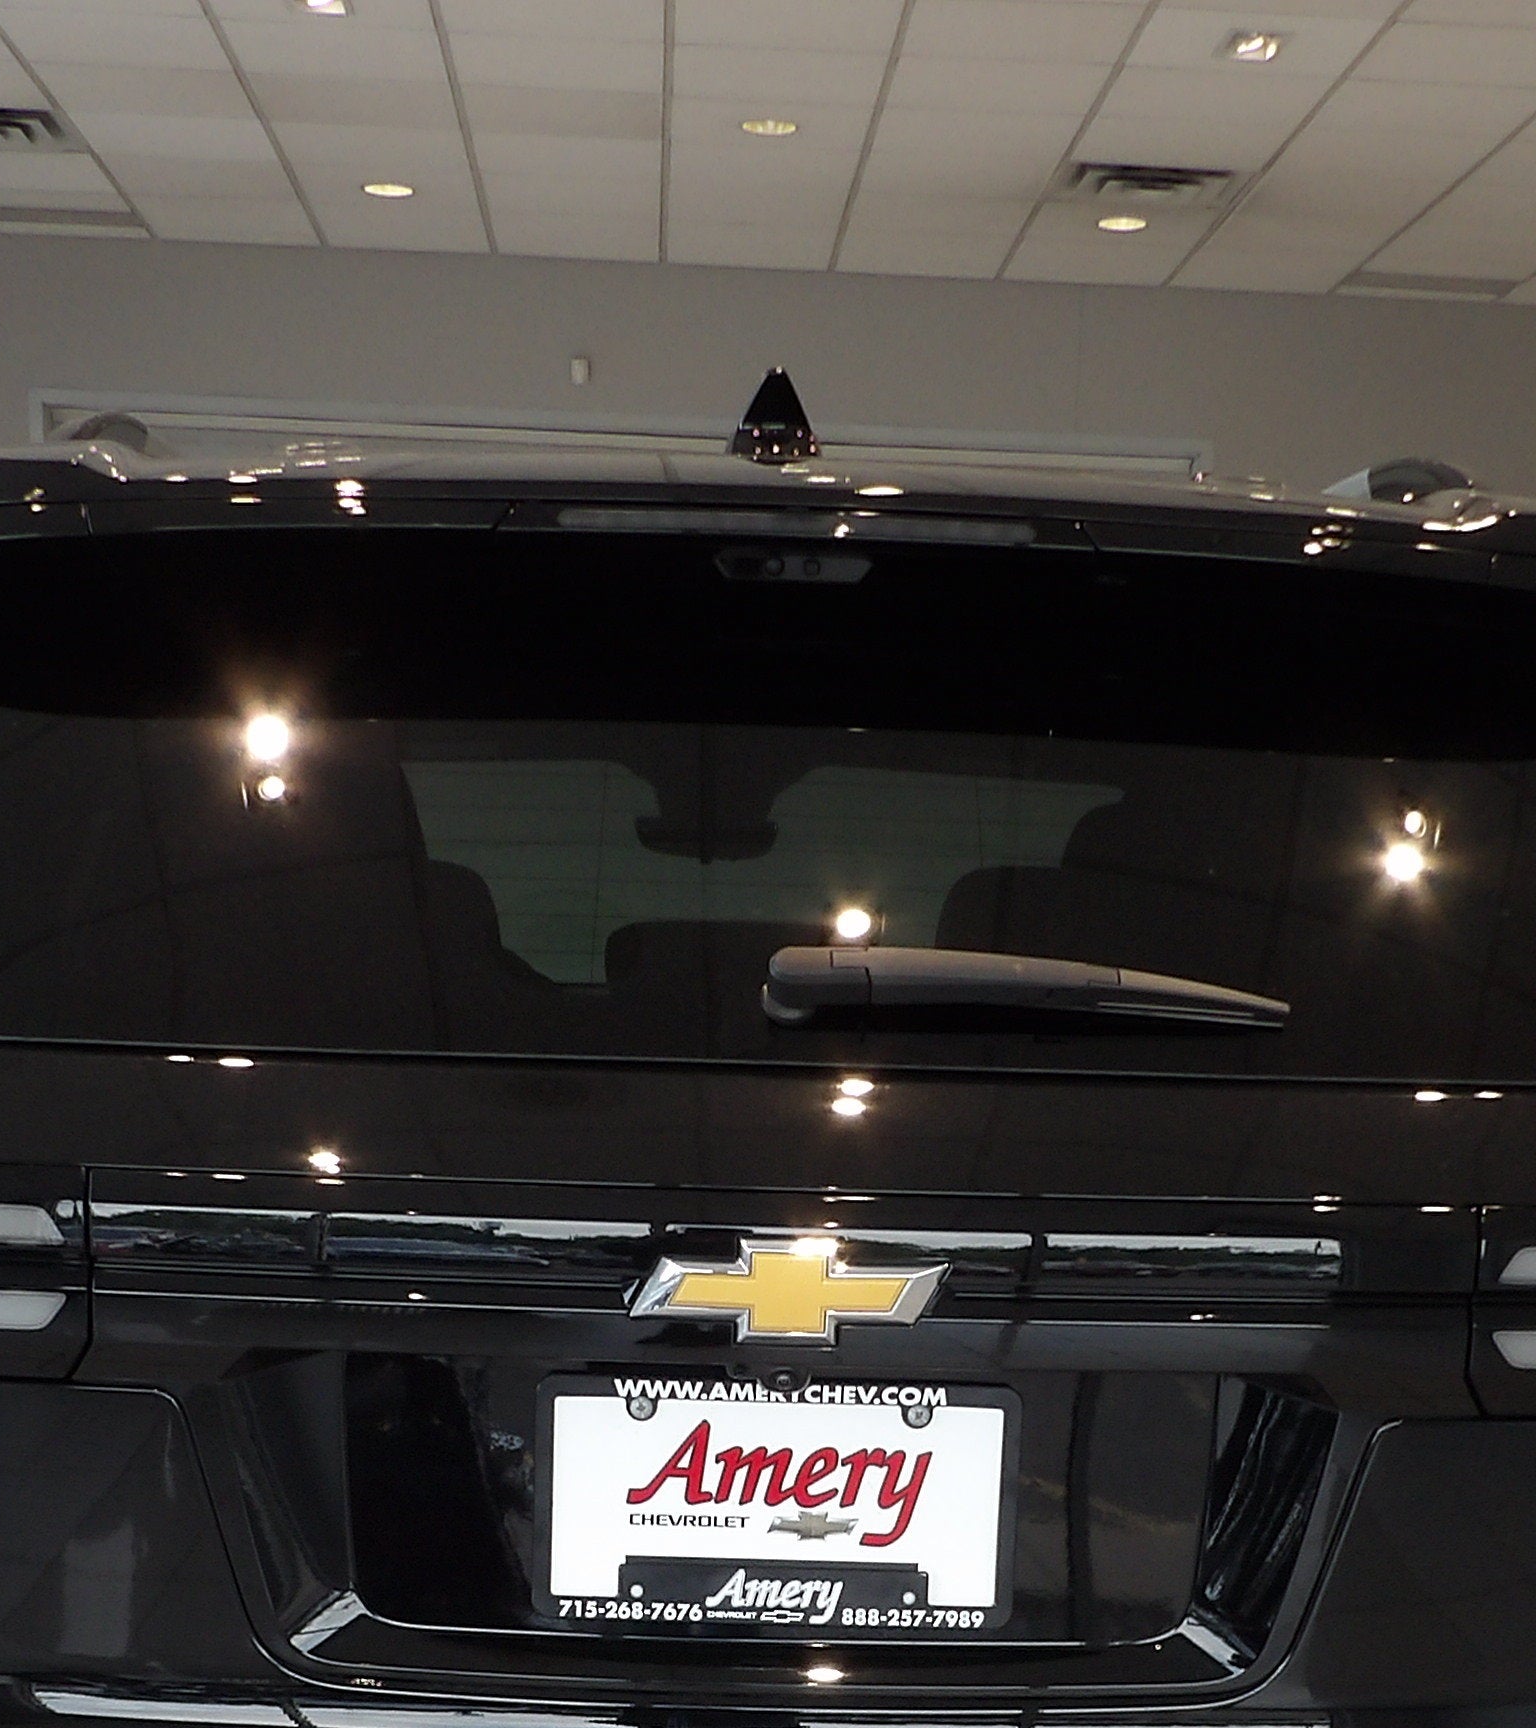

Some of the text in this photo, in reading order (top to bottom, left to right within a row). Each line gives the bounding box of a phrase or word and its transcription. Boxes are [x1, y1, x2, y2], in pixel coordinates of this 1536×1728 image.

[626, 1419, 933, 1547] Amery
[629, 1513, 751, 1529] CHEVROLET
[705, 1568, 844, 1625] Amery
[559, 1600, 703, 1622] 715-268-7676
[841, 1607, 985, 1629] 888-257-7989
